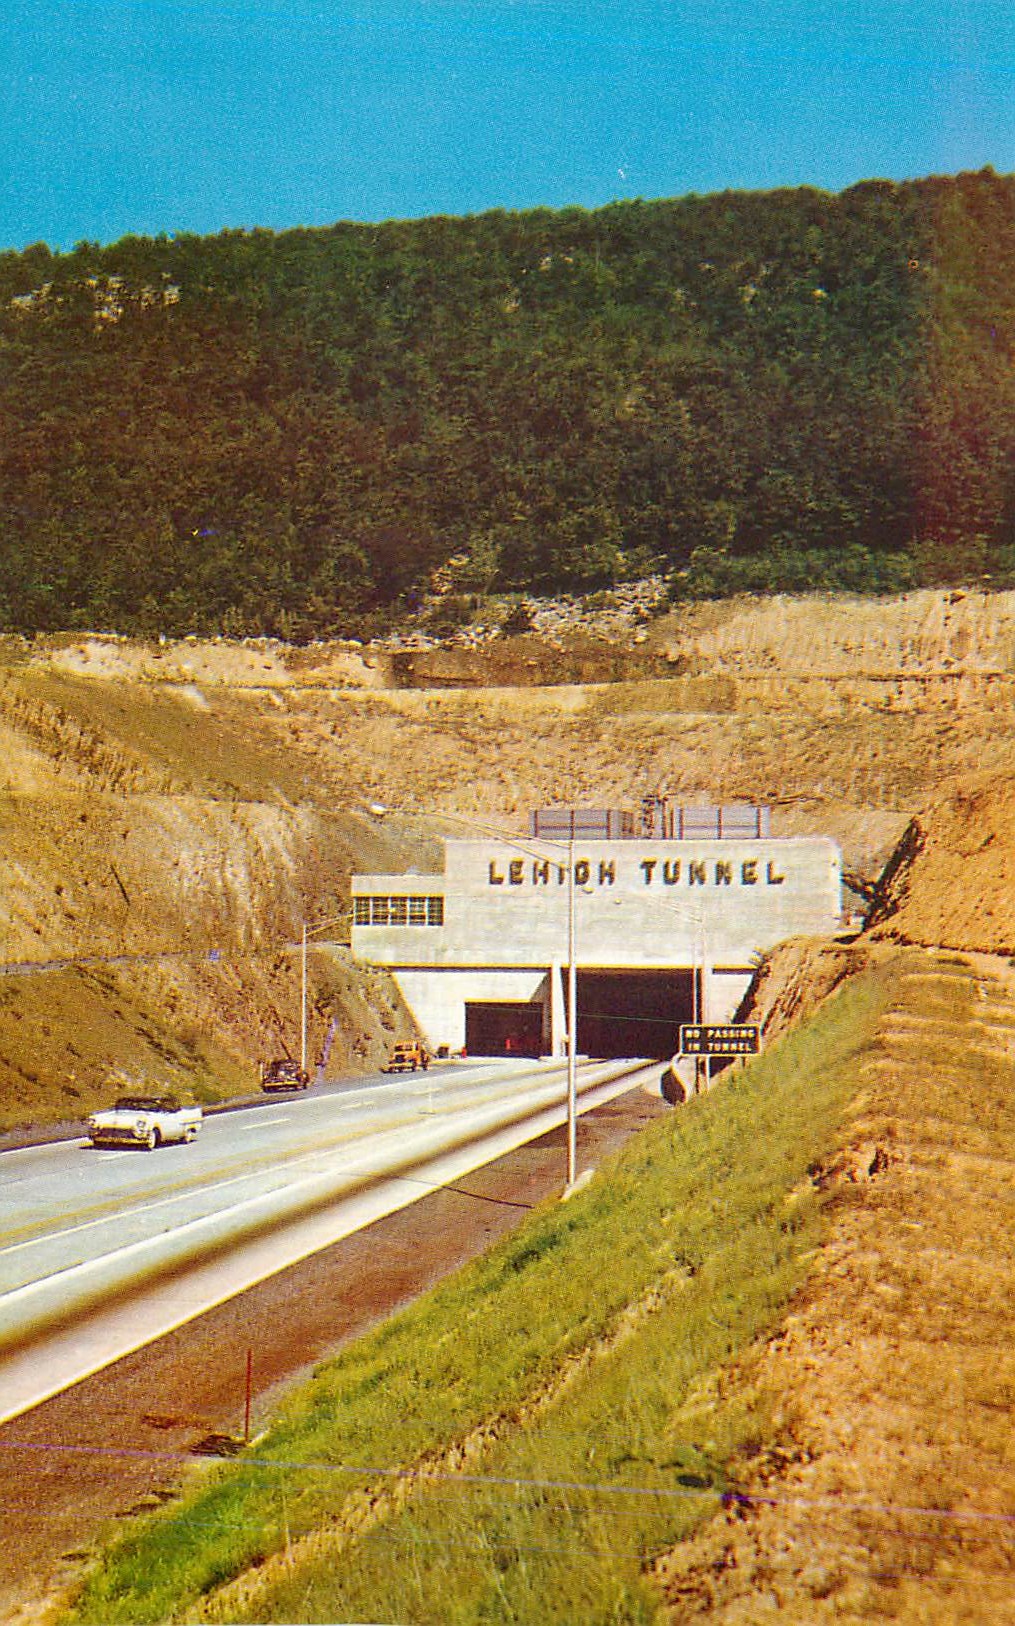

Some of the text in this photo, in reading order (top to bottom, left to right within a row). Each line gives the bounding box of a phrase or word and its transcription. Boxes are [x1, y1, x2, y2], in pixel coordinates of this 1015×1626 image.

[488, 857, 786, 885] LEHIGH TUNNEL
[685, 1029, 755, 1039] NO PASSING
[687, 1042, 752, 1051] IN TUNNEL
